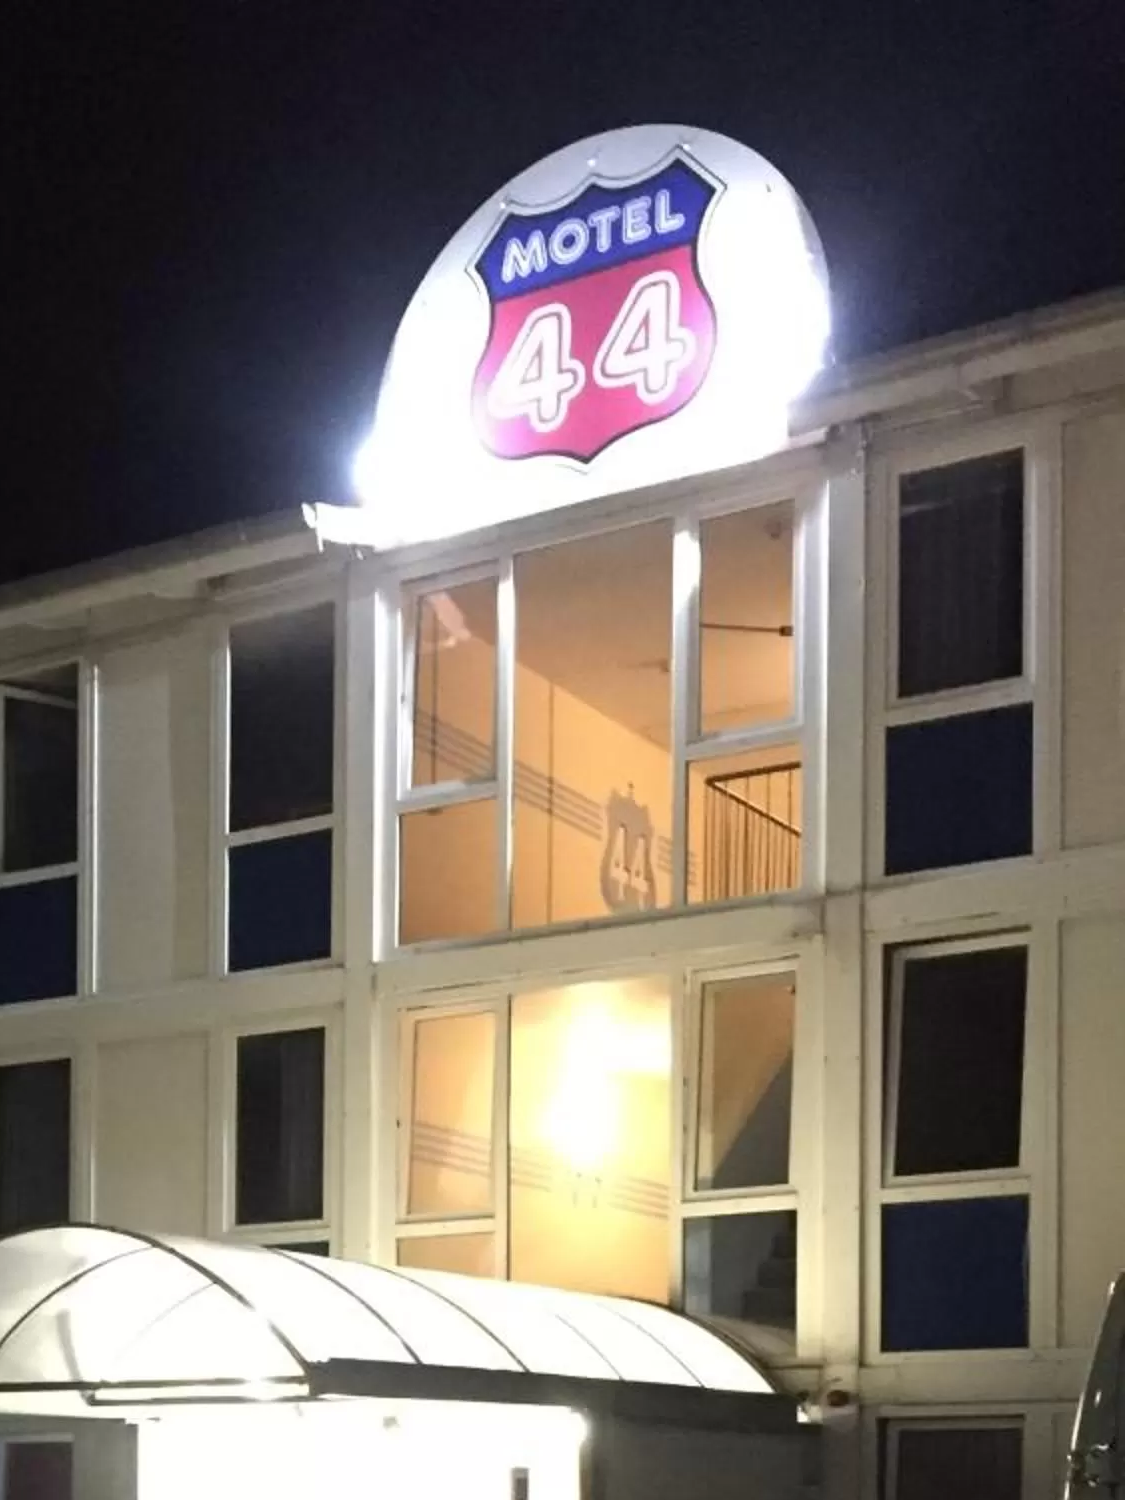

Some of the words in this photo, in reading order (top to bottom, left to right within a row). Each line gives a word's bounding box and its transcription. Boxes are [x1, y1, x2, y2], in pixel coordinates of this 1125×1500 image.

[501, 189, 685, 283] MOTEL
[486, 270, 696, 434] 44
[610, 822, 650, 911] 44
